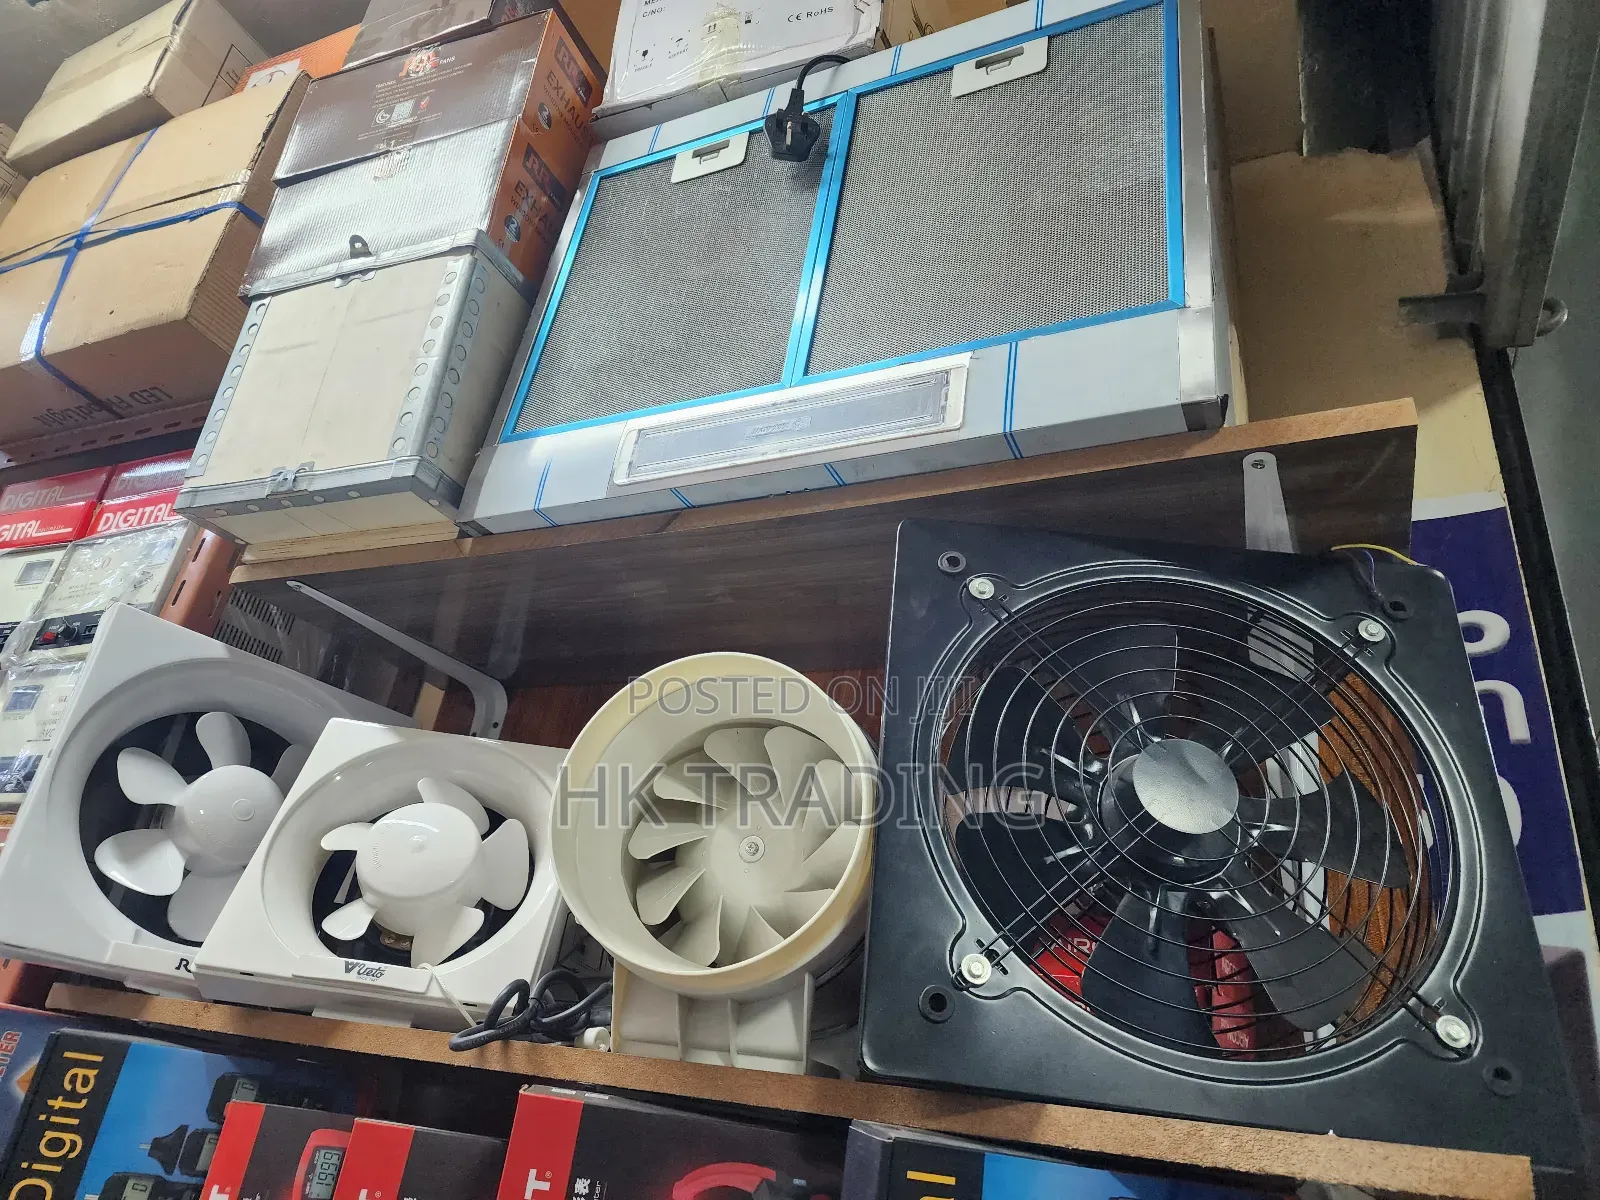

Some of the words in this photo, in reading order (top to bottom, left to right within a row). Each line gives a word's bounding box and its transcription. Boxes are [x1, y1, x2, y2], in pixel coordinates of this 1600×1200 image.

[806, 6, 834, 18] RoHS
[128, 386, 173, 405] LED
[2, 485, 64, 509] DIGITAL
[96, 503, 175, 533] DIGITAL
[357, 961, 387, 979] Veto
[8, 1051, 104, 1200] Digital
